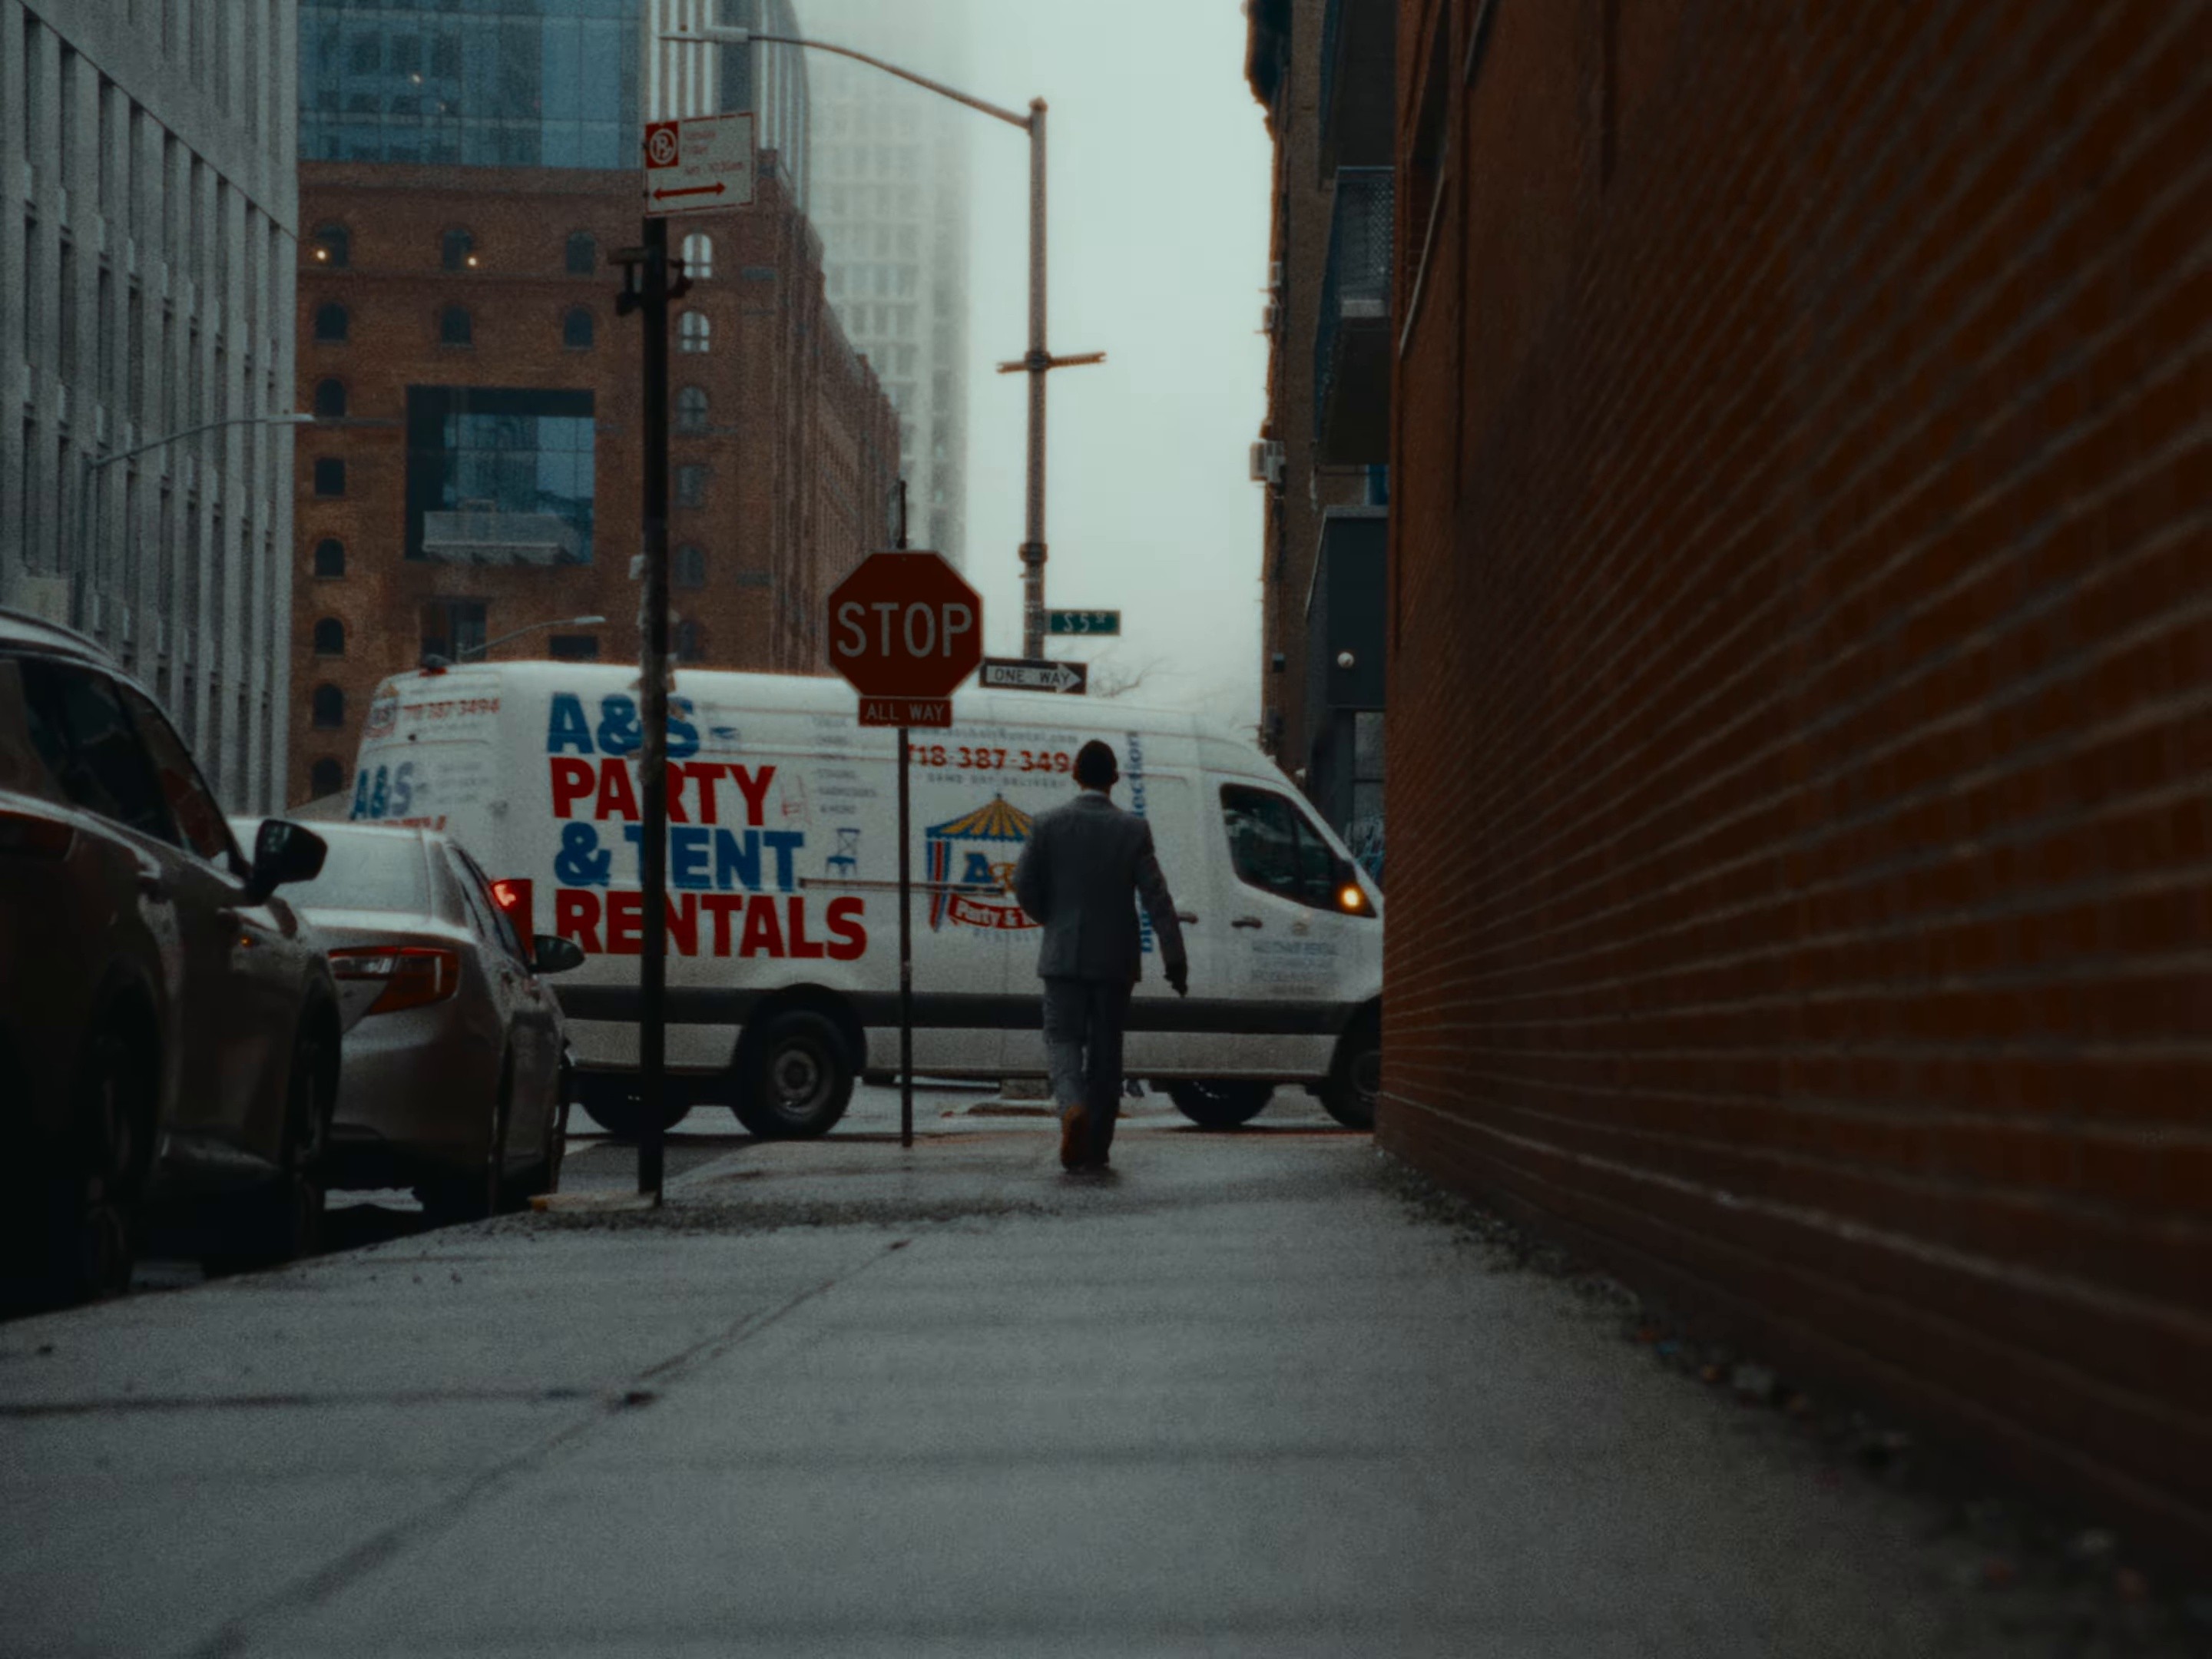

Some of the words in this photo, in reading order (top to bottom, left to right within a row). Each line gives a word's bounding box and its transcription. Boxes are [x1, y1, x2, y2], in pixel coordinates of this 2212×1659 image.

[837, 602, 972, 657] STOP
[1063, 612, 1074, 632] S
[994, 668, 1025, 682] ONE
[1038, 671, 1071, 684] WAY
[865, 703, 899, 720] ALL
[909, 704, 945, 722] WAY
[908, 743, 1073, 773] 718-387-349
[550, 757, 777, 826] PARTY
[555, 821, 612, 887] &
[555, 889, 868, 961] RENTALS
